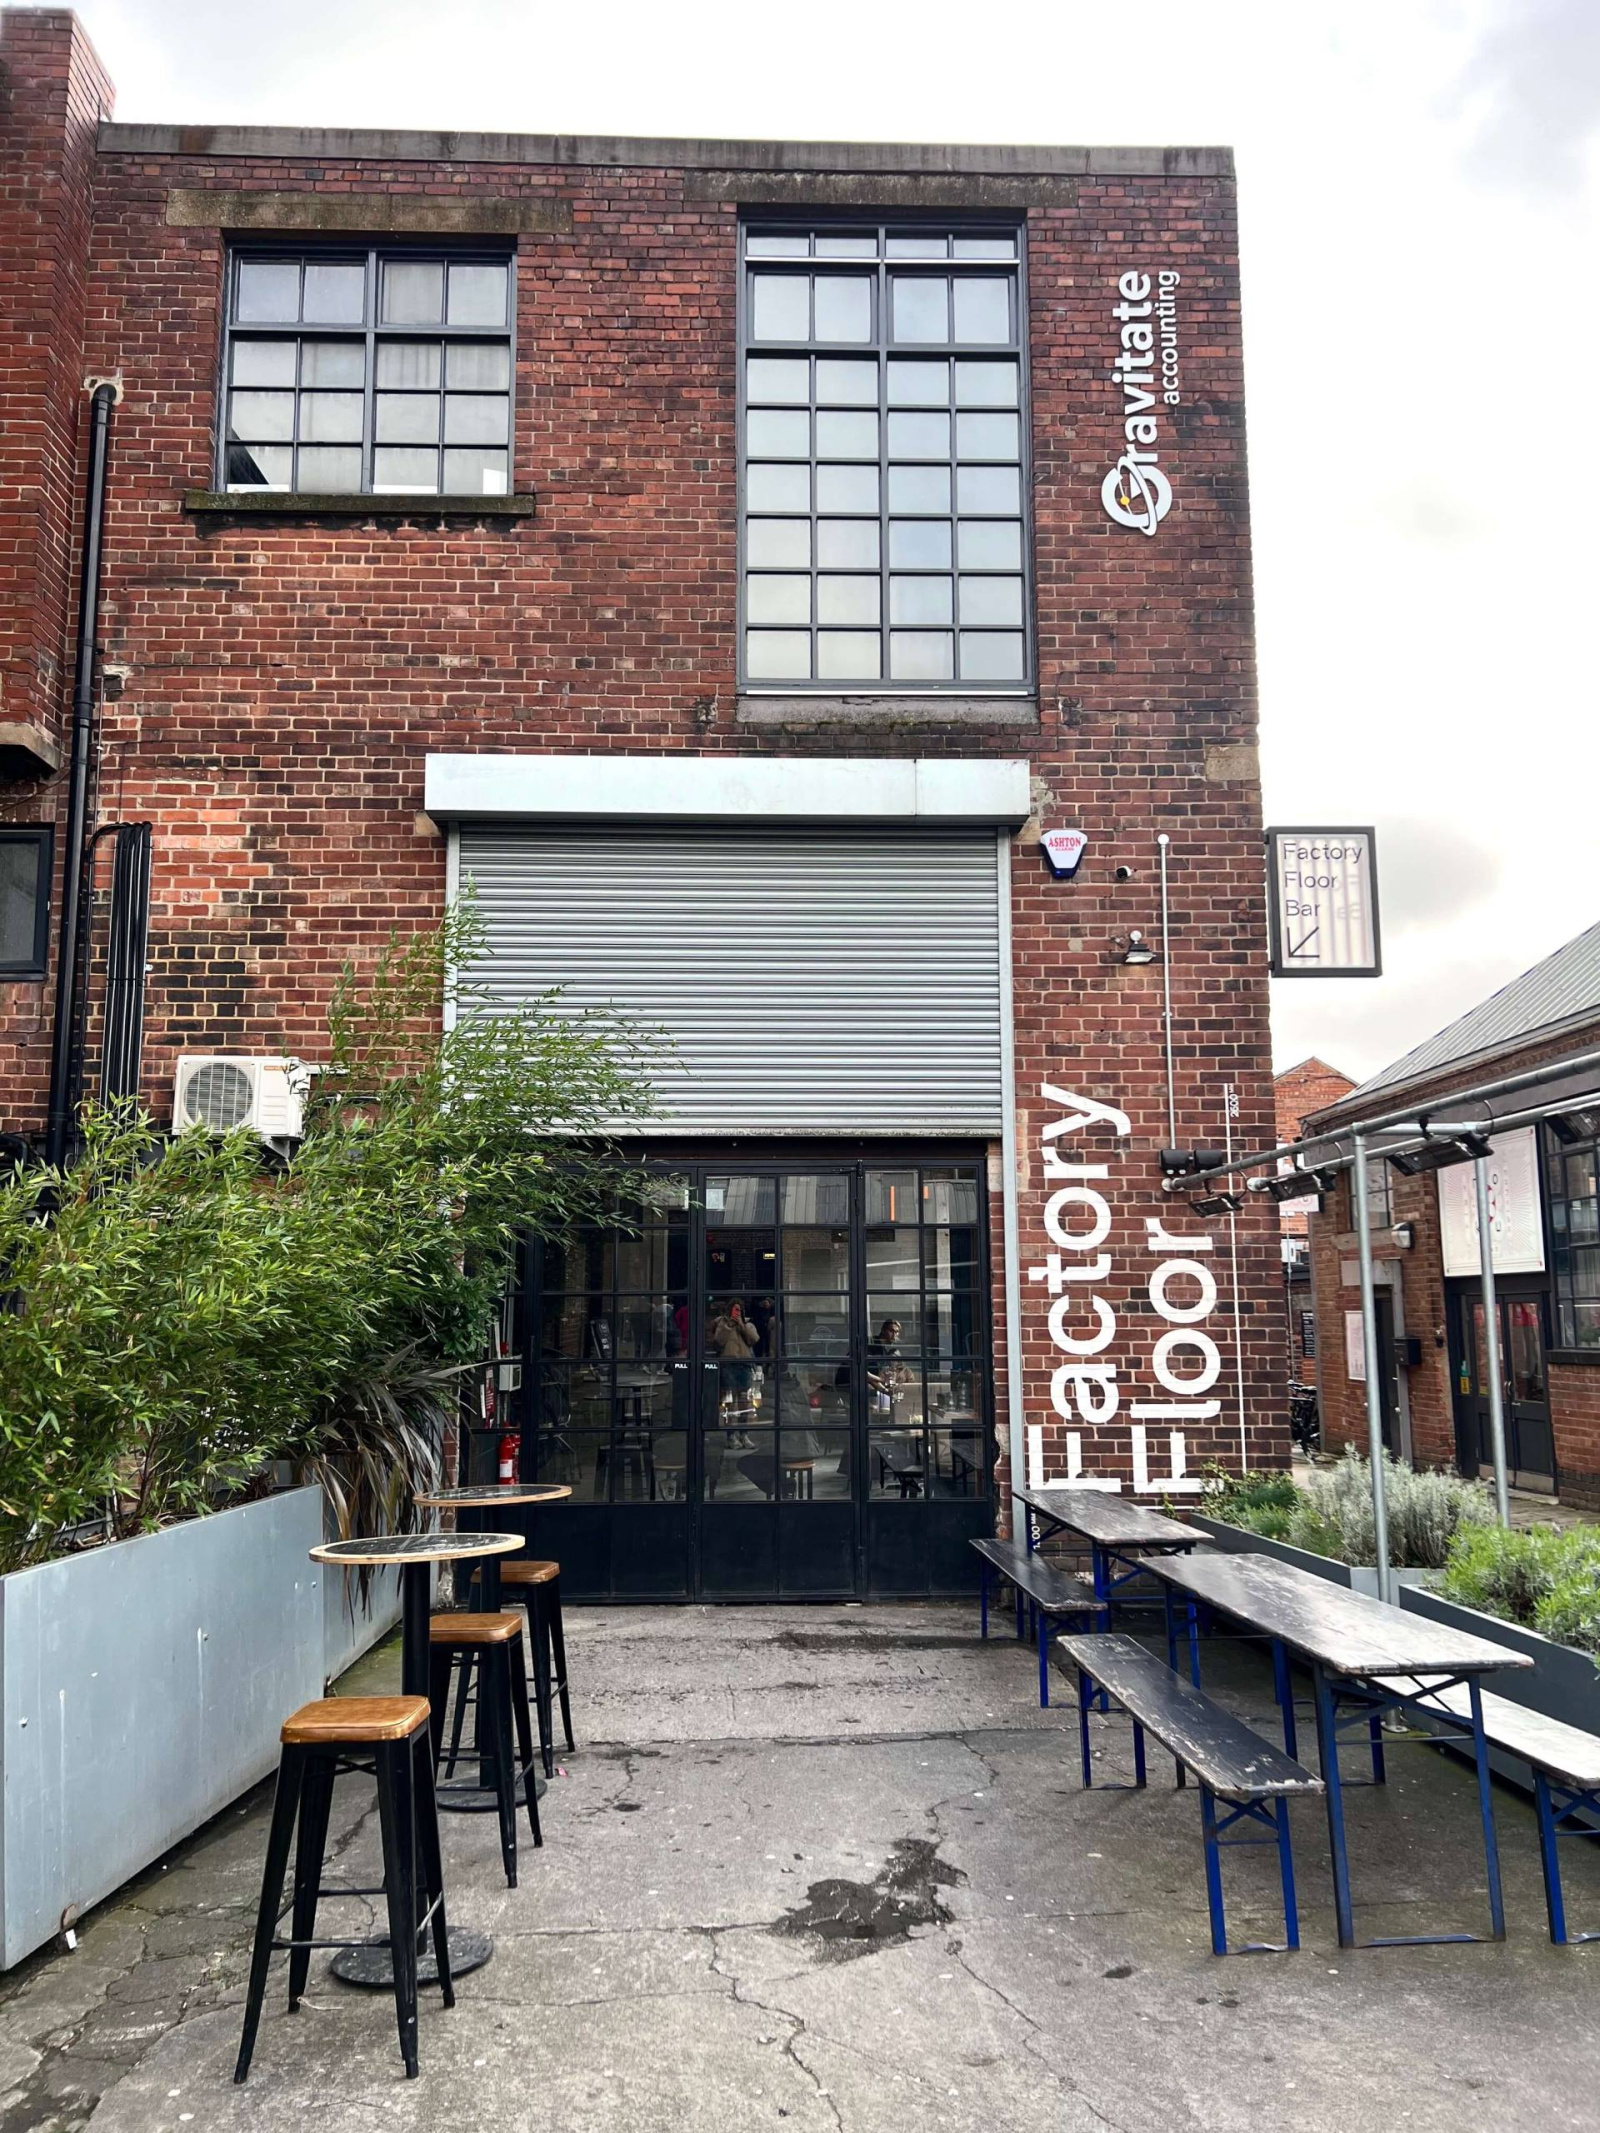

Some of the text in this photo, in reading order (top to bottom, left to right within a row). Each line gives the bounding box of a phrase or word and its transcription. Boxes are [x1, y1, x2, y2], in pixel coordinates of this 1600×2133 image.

[1154, 270, 1180, 405] accounting
[1101, 270, 1173, 536] Gravitate
[1048, 837, 1081, 847] ASHTON
[1283, 842, 1362, 864] Factory
[1284, 871, 1338, 888] Floor
[1286, 899, 1320, 917] Bar
[1229, 1094, 1239, 1117] 2600
[1028, 1082, 1131, 1493] Factory
[1130, 1217, 1224, 1494] Floor
[1031, 1526, 1041, 1549] 100
